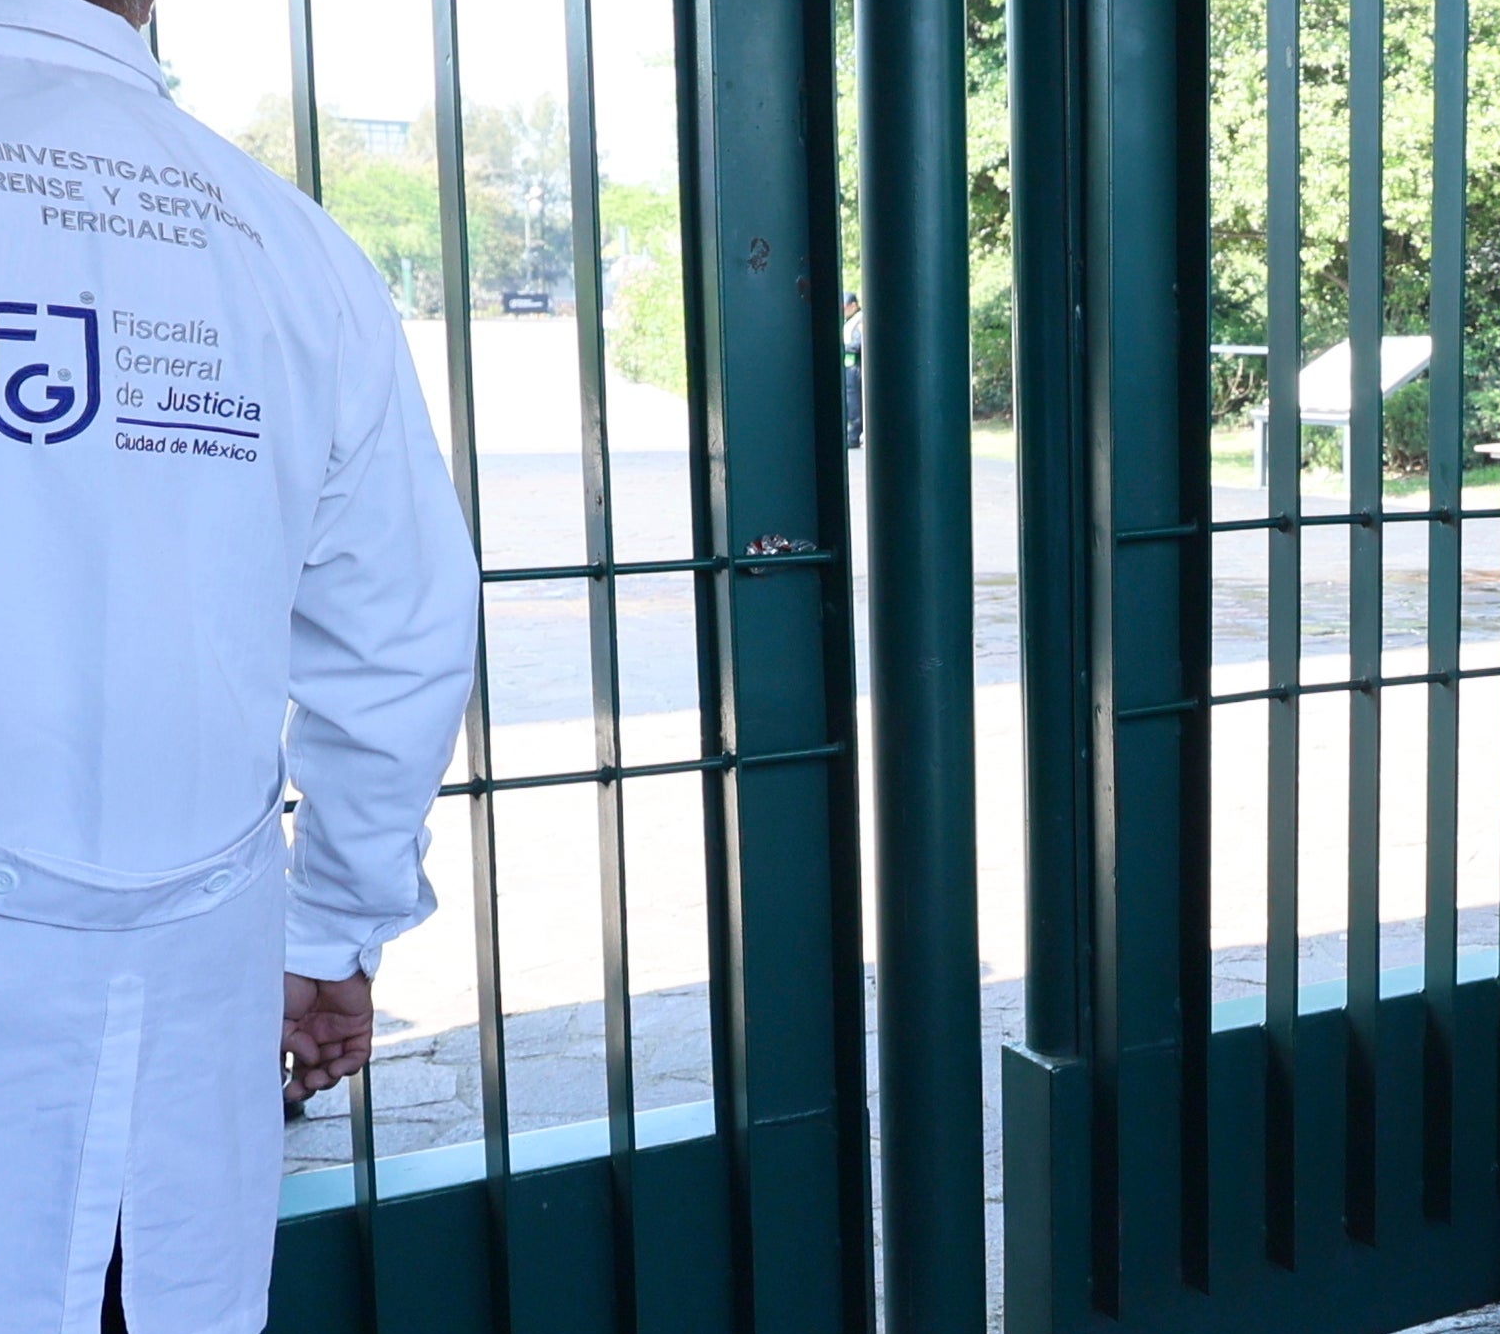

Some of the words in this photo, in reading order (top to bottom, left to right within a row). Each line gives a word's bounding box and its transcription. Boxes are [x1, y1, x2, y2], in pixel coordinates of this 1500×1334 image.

[41, 205, 208, 249] PERICIALES
[102, 185, 121, 206] Y
[138, 191, 264, 249] SERVICIOS
[112, 310, 219, 348] Fiscalía
[115, 345, 222, 381] General
[116, 382, 144, 408] de
[157, 386, 261, 422] Justicia
[115, 432, 166, 453] Ciudad
[170, 437, 188, 454] de
[192, 439, 258, 463] México
